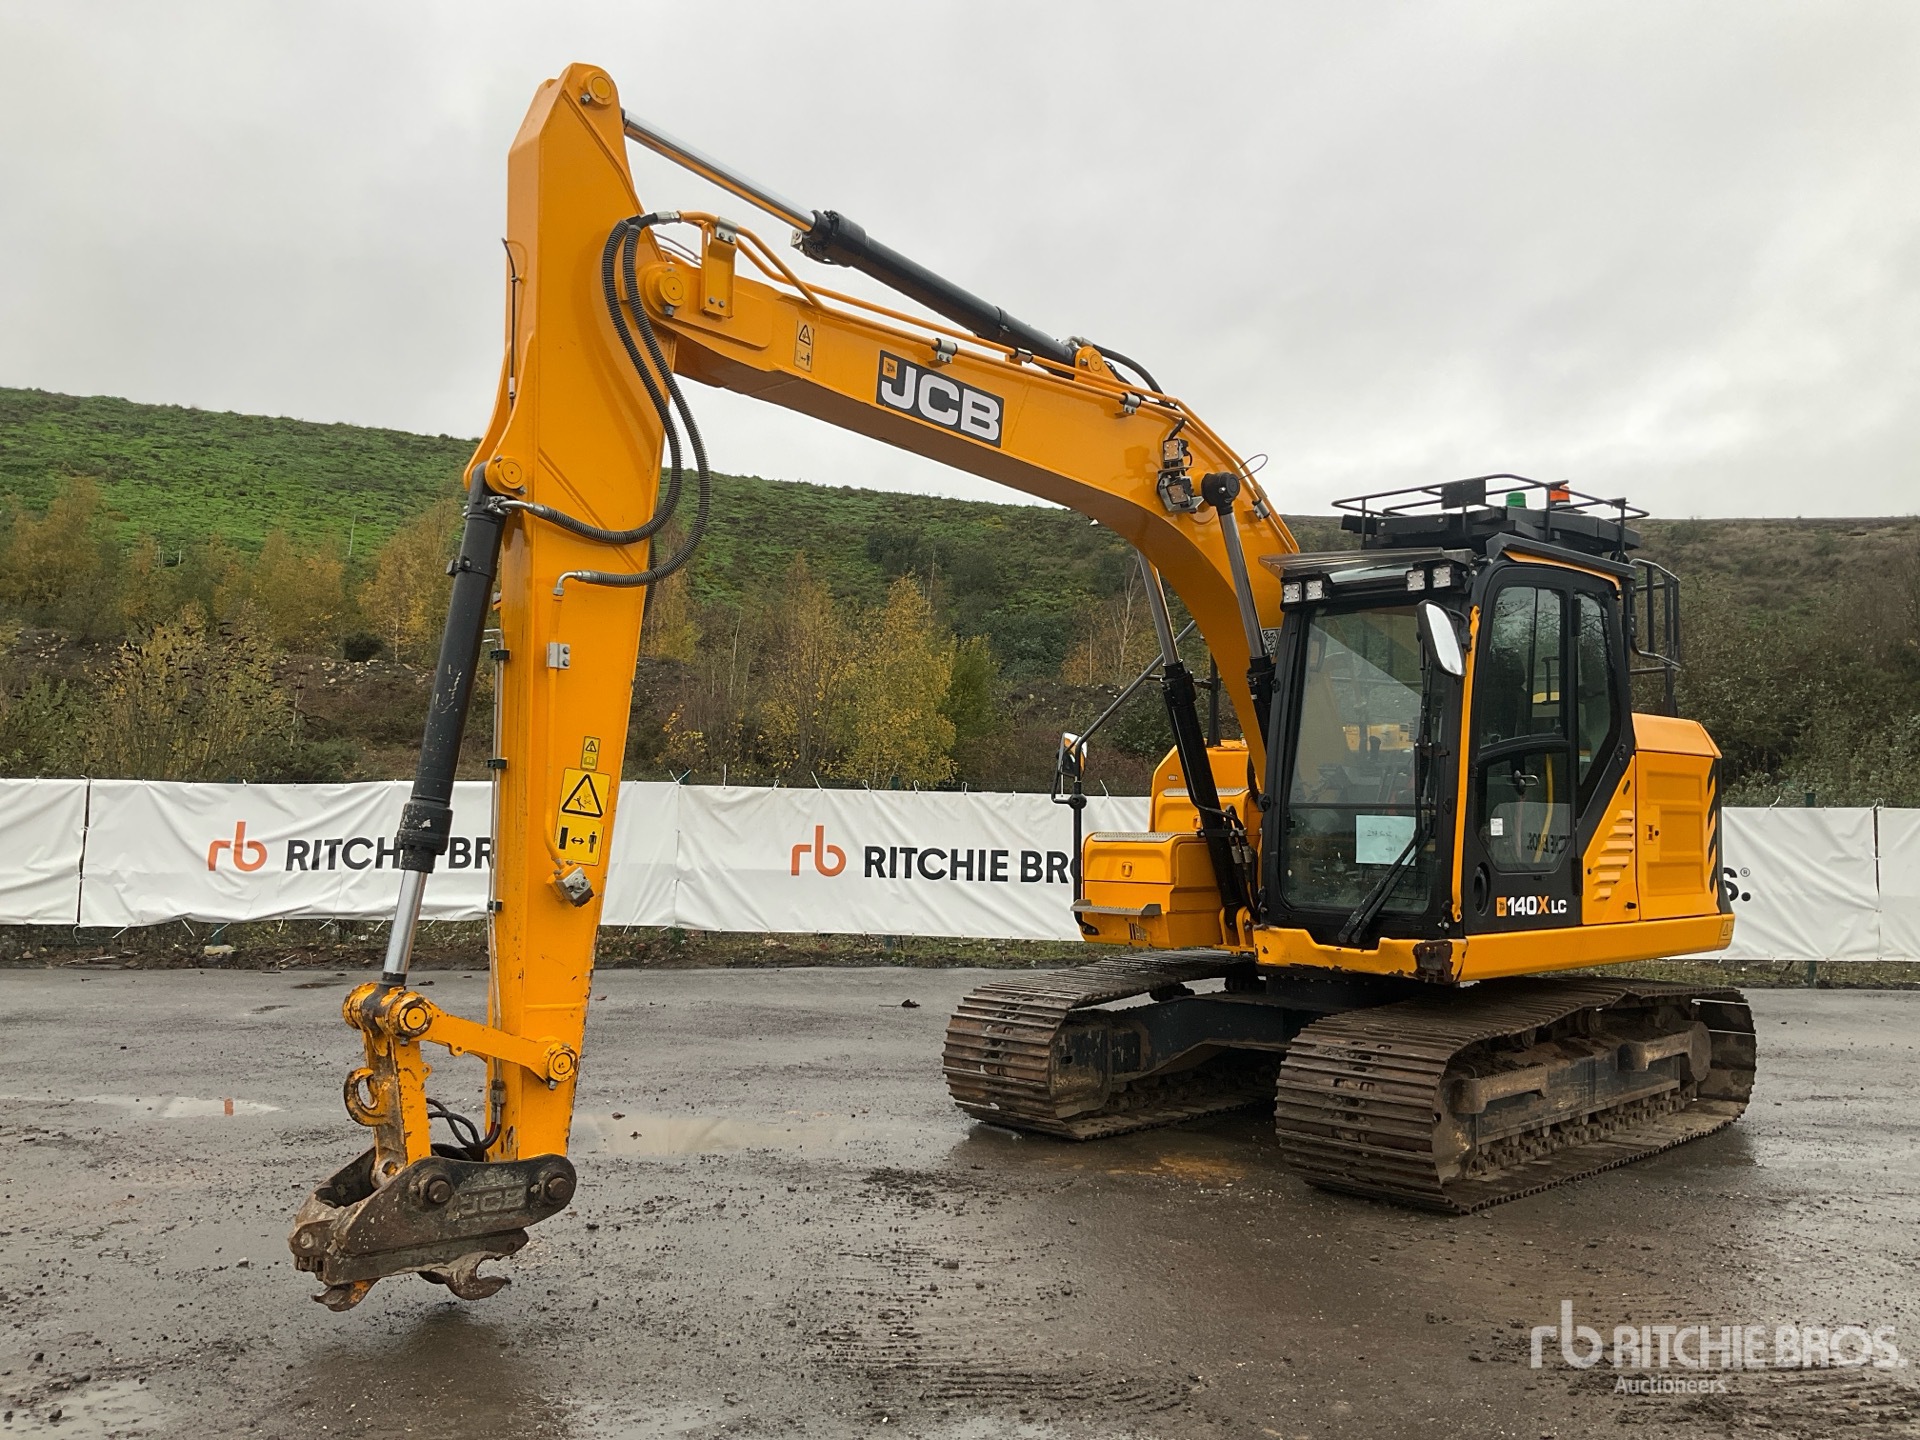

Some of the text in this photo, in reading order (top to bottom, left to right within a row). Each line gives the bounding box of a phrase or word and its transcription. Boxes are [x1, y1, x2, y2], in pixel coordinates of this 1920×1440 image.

[881, 365, 1000, 441] JCB
[207, 821, 491, 872] rb RITCH BR
[791, 825, 1074, 884] rb RITCHIE BR
